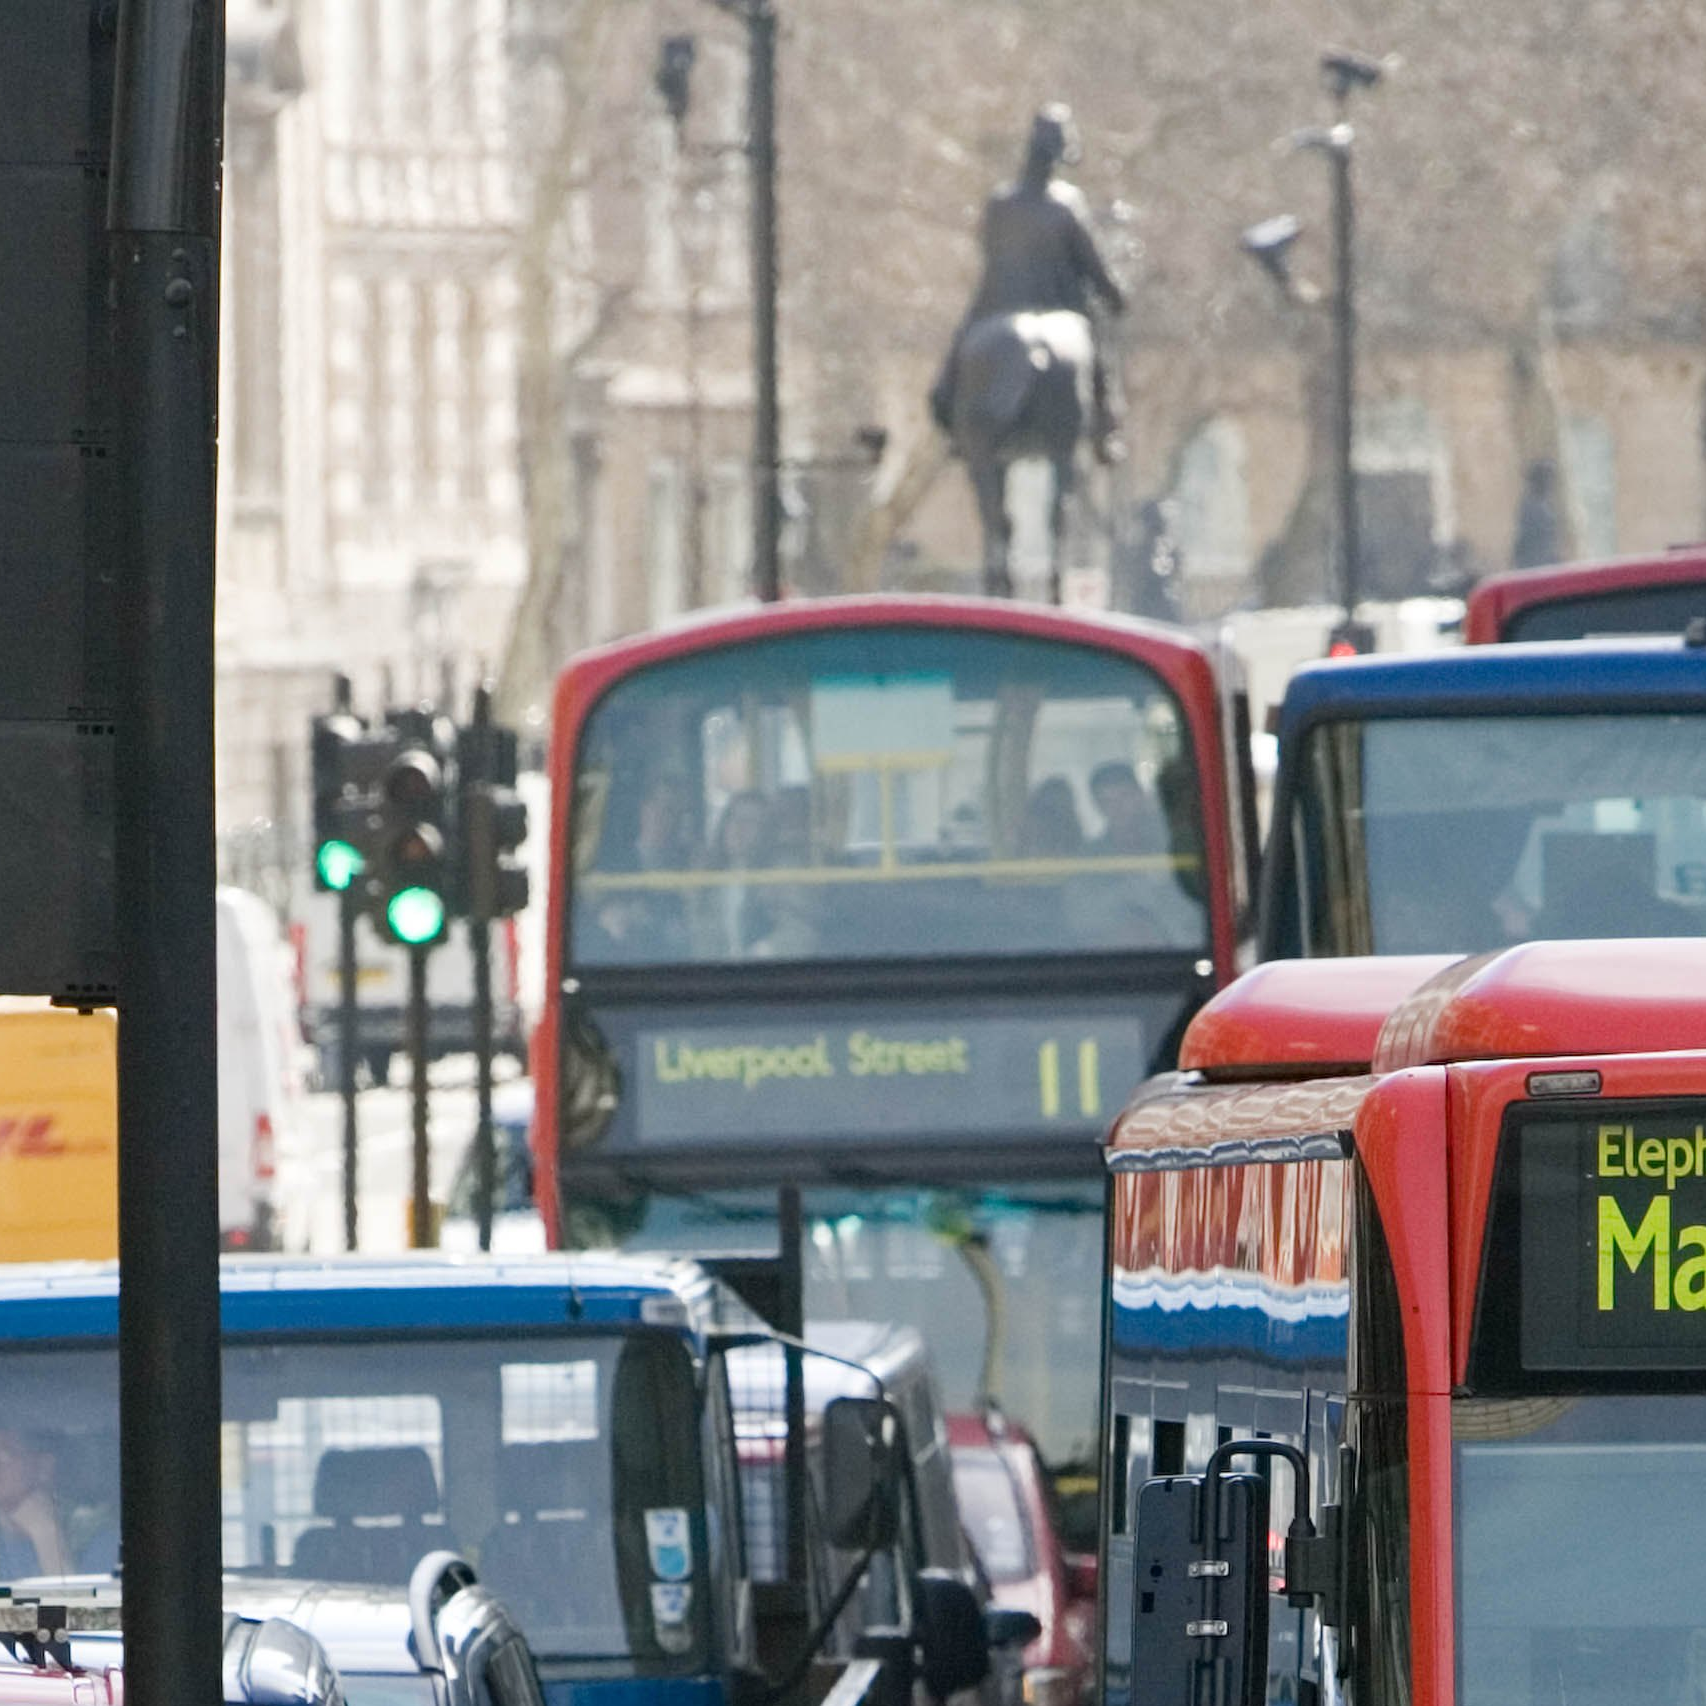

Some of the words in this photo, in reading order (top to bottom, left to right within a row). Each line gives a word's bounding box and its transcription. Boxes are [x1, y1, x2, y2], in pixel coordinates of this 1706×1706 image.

[654, 1033, 835, 1089] Liverpool
[847, 1030, 969, 1076] Street
[1038, 1038, 1100, 1119] 11
